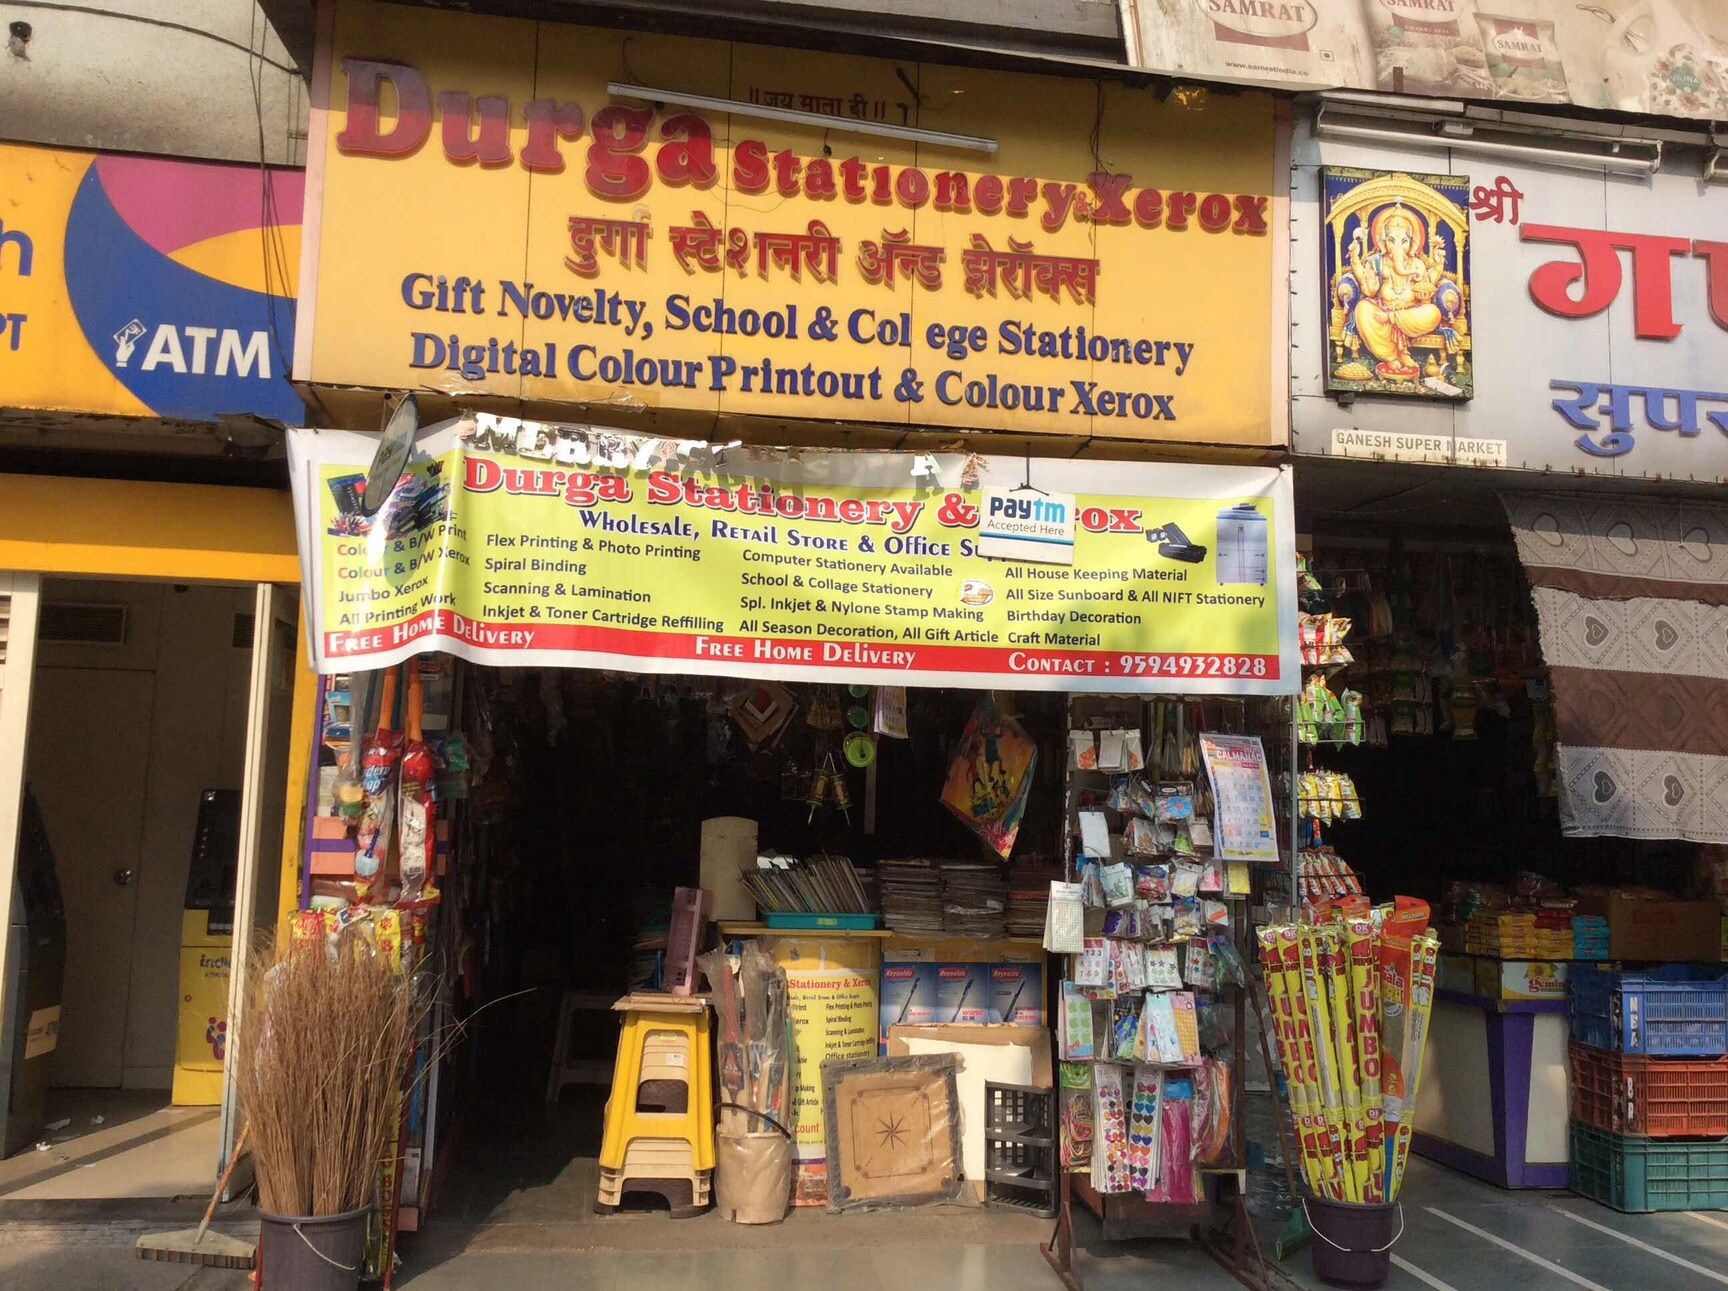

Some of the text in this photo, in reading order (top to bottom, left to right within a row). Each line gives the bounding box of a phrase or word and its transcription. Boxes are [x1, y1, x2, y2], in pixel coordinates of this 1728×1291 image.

[1208, 0, 1305, 22] SAMRAT
[1496, 39, 1542, 53] SAMRAT
[336, 57, 719, 202] Durga
[733, 140, 1079, 233] Stationery
[1087, 172, 1270, 238] Xerox
[1469, 175, 1524, 226] श्री
[401, 271, 484, 314] Gift
[497, 280, 653, 341] Novelty,
[664, 293, 798, 340] School
[807, 305, 838, 341] &
[998, 320, 1195, 376] Stationery
[141, 323, 271, 379] ATM
[409, 331, 1176, 422] Digital Colour Printout & Colour Xerox
[1336, 432, 1392, 448] GANESH
[1396, 437, 1442, 451] SUPER
[463, 455, 981, 534] Durga Stationery &
[409, 528, 435, 549] B/W
[438, 525, 467, 541] Print
[987, 519, 1065, 536] Accepted Here
[486, 534, 701, 561] Flex Printing & Photo Printing
[858, 535, 876, 553] &
[409, 550, 435, 571] B/W
[485, 558, 587, 576] Spiral Binding
[742, 549, 953, 577] Computer Stationery Available
[1005, 567, 1187, 582] All House Keeping Material
[395, 576, 428, 597] Xerox
[483, 582, 651, 602] Scanning & Lamination
[741, 573, 933, 599] School & Collage Stationery
[1006, 588, 1265, 608] All Size Sunboard & All NIFT Stationery
[483, 605, 724, 633] Inkjet & Toner Cartridge Reffilling
[740, 596, 984, 622] Spl. Inkjet & Nylone Stamp Making
[1007, 610, 1142, 625] Birthday Decoration
[739, 620, 999, 643] All Season Decoration, All Gift Article
[1008, 632, 1101, 646] Craft Material
[1120, 655, 1266, 676] 9594932828
[788, 979, 841, 990] Stationery
